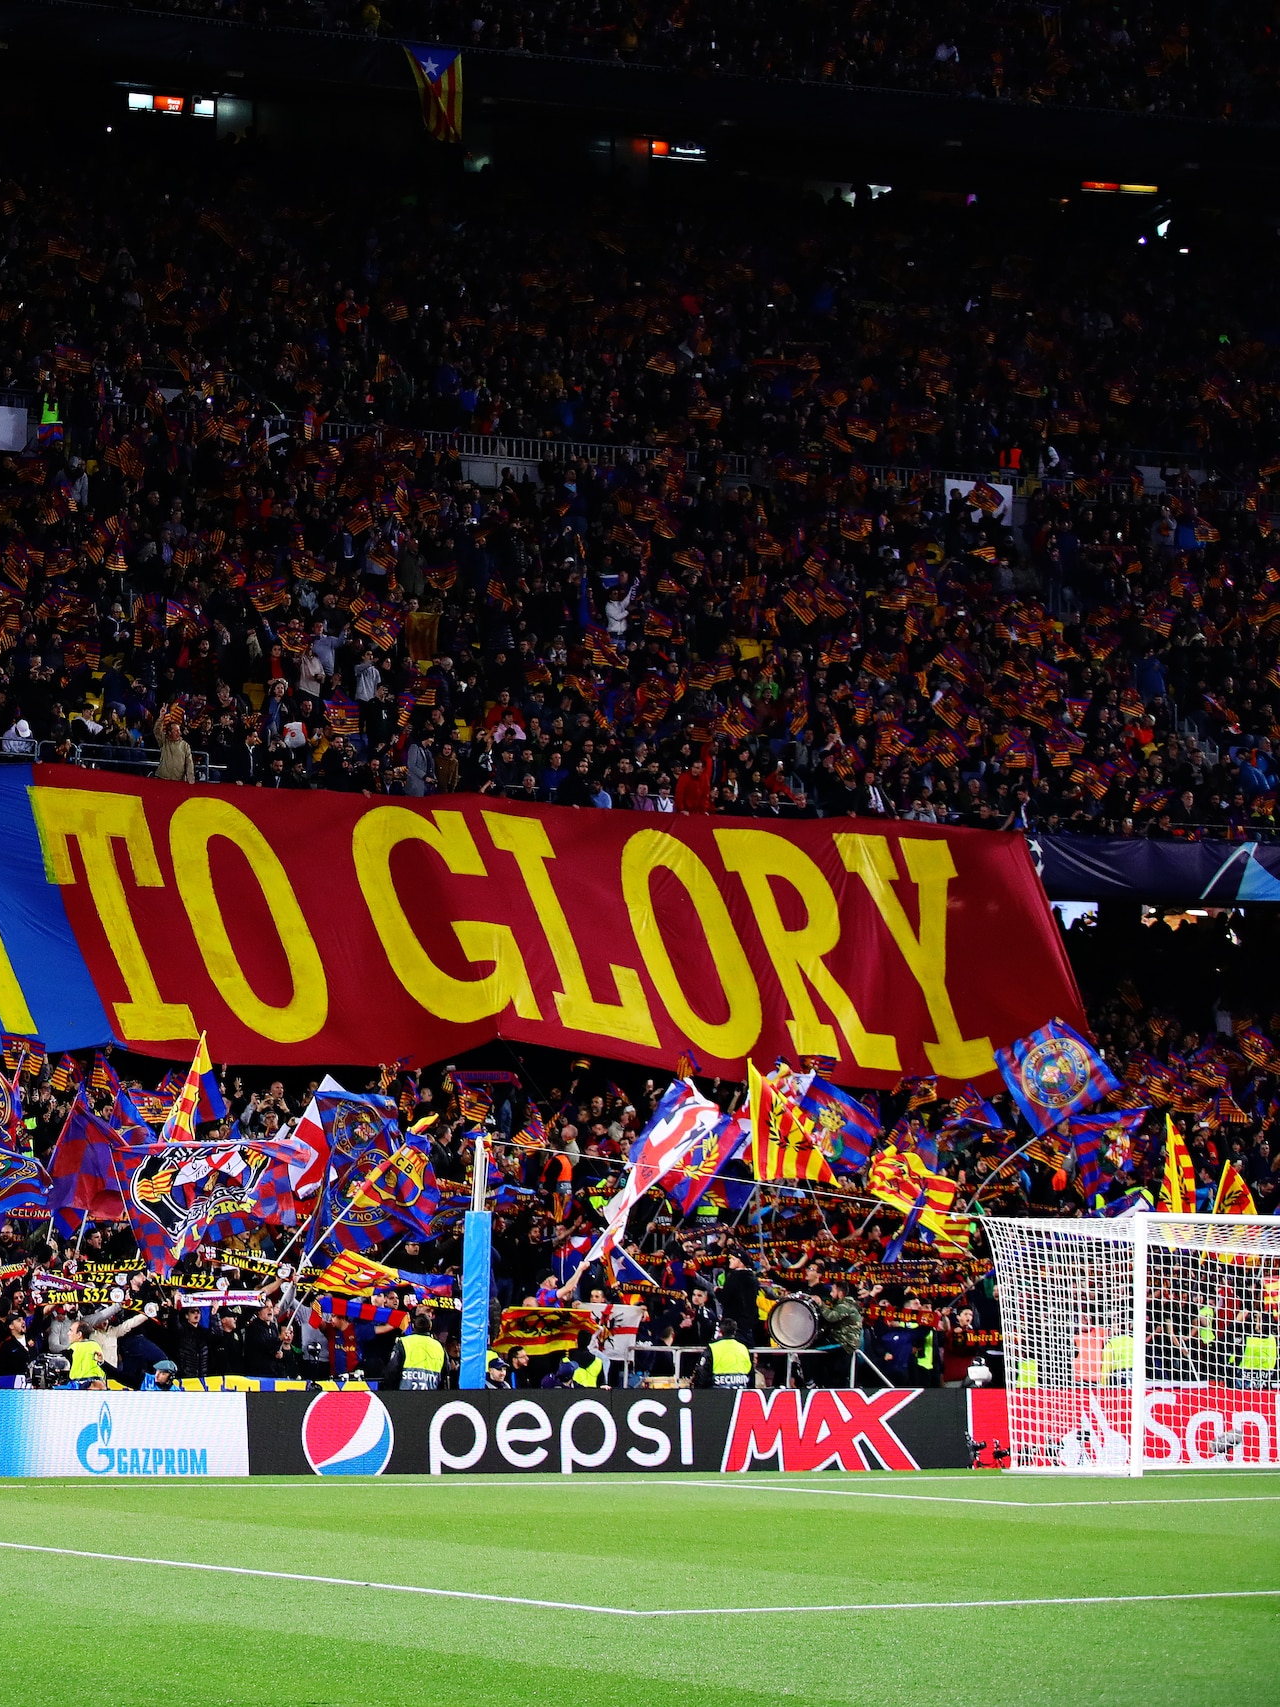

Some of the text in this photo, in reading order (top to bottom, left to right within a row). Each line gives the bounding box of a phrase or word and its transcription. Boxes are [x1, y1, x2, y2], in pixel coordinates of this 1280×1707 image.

[28, 785, 329, 1043] TO
[352, 805, 996, 1079] GLORY
[186, 1273, 215, 1289] 532
[47, 1288, 109, 1304] Front 532
[429, 1388, 924, 1474] pepsi MAX
[116, 1446, 208, 1475] GAZPROM
